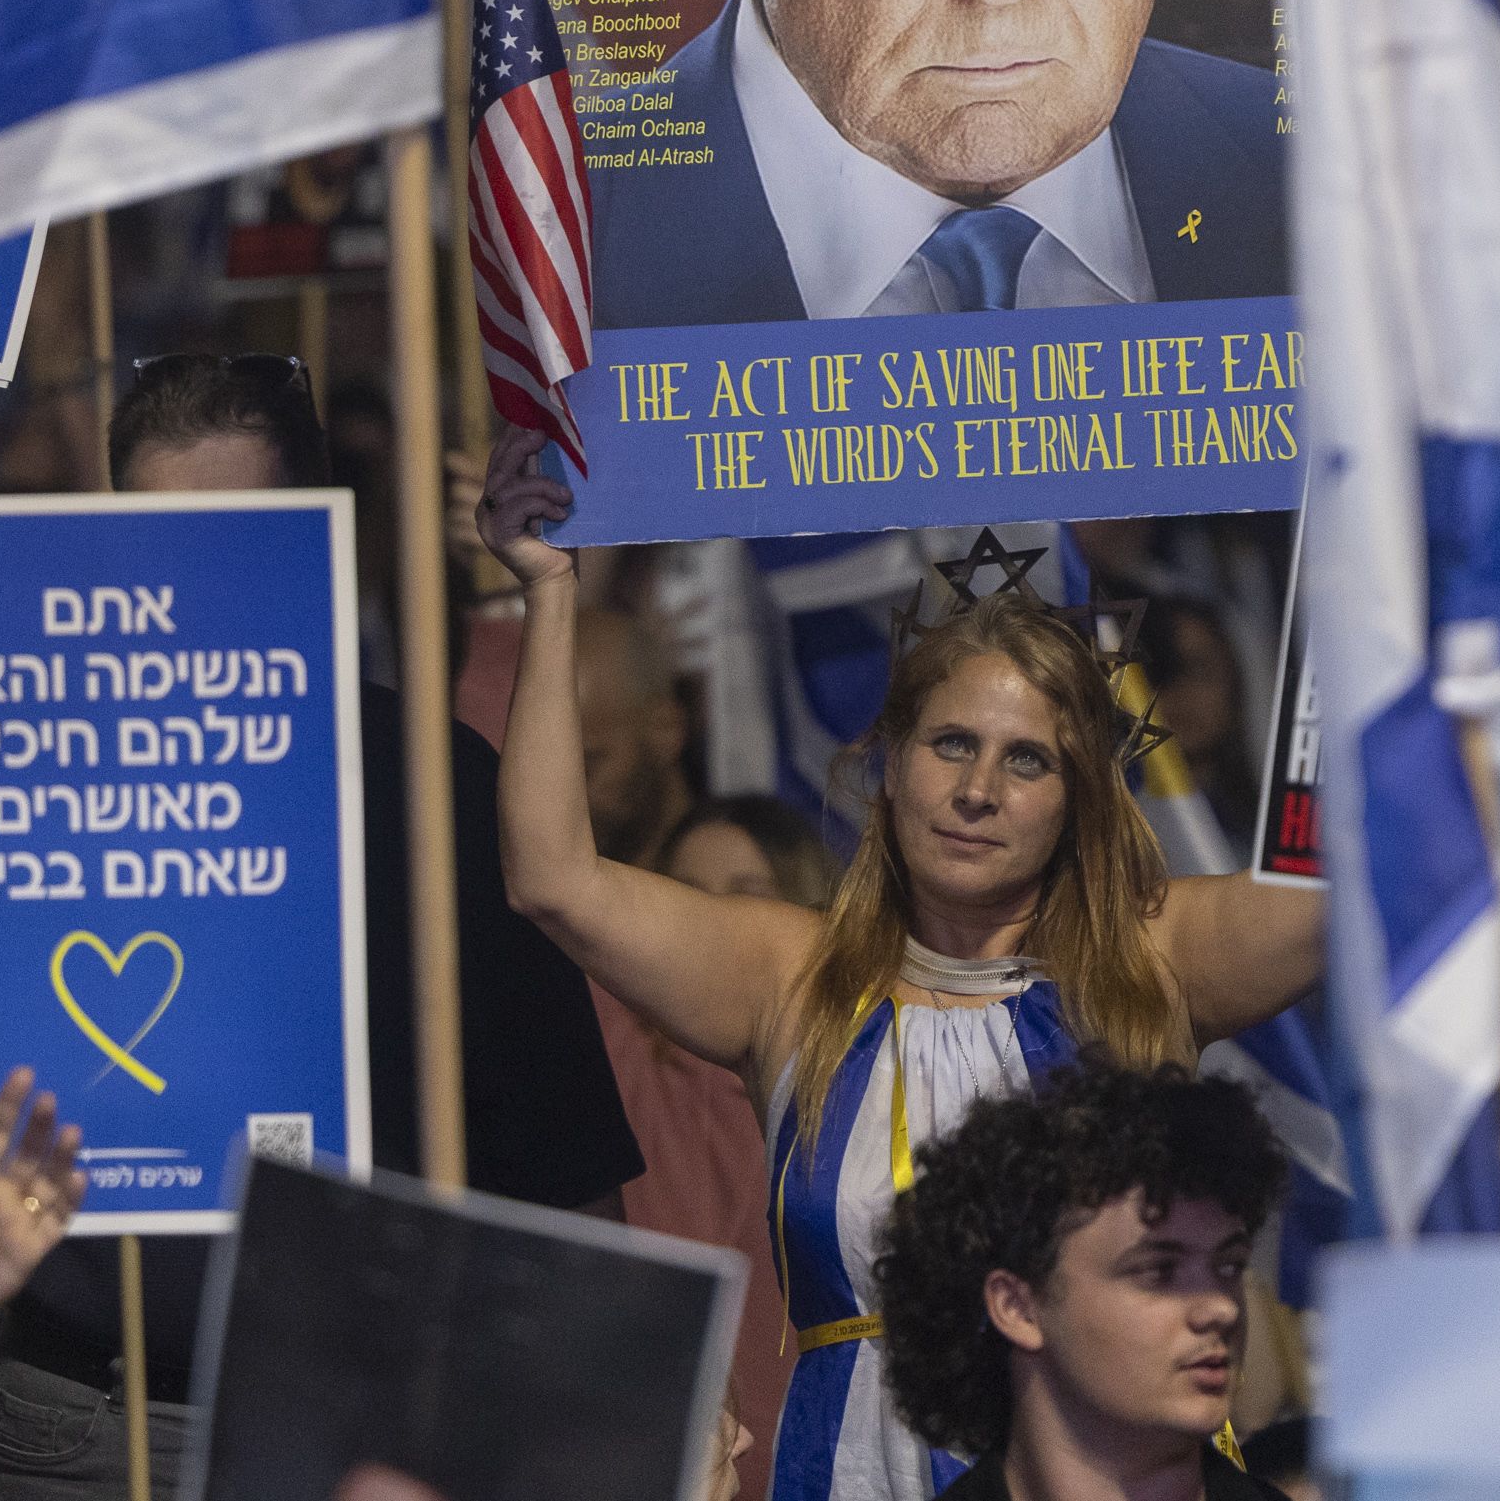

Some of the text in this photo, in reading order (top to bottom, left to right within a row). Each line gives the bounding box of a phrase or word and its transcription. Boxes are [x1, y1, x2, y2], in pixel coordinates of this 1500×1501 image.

[557, 13, 681, 35] ana Boochboot
[576, 41, 666, 62] Breslavsky
[589, 68, 678, 89] Zangauker
[631, 92, 674, 111] Dalal
[583, 119, 706, 140] Chaim Ochana
[583, 146, 714, 169] mmad Al-Atrash
[609, 331, 1306, 422] THE ACT OF SAVING ONE LIFE EAR
[685, 403, 1298, 491] THE WORLD'S ETERNAL THANKS
[43, 585, 177, 636] אתם
[84, 648, 308, 700] הנשימה
[119, 704, 291, 767] שלהם
[105, 846, 287, 898] שאתם
